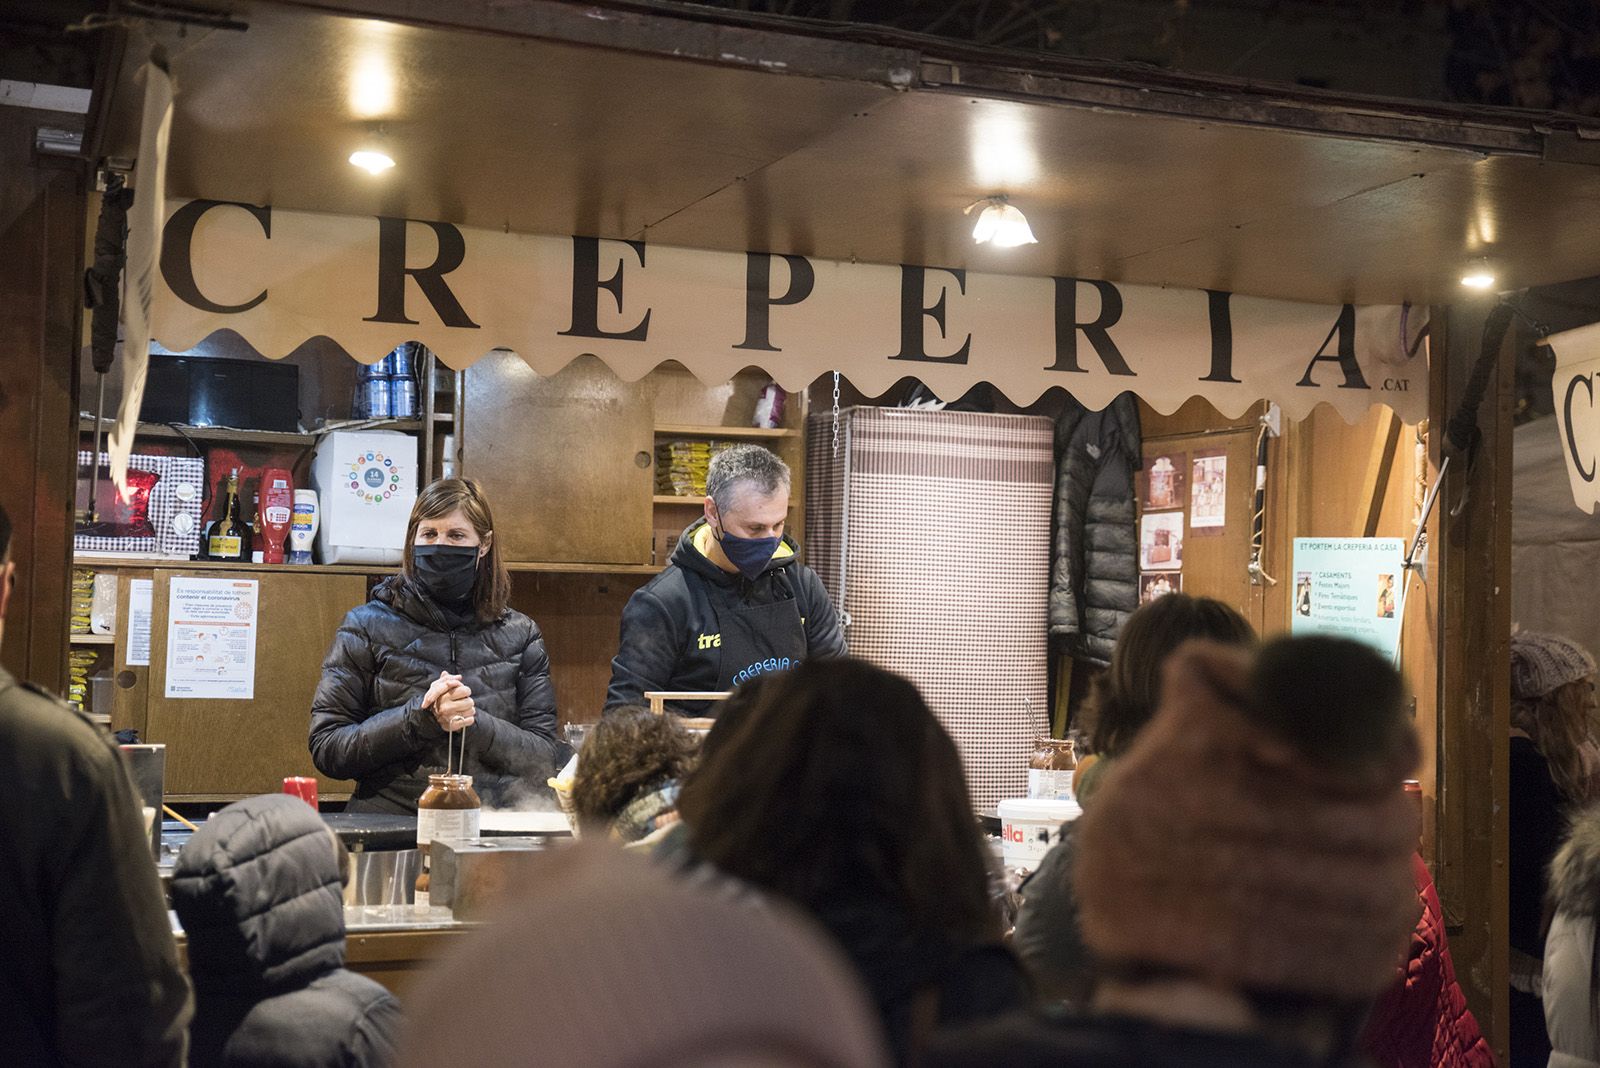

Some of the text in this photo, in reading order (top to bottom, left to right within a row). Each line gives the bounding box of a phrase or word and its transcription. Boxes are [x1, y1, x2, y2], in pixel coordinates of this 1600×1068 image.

[159, 199, 1410, 391] CREPERIA .CAT
[1563, 370, 1600, 482] C
[1343, 543, 1372, 551] CREPERIA
[732, 656, 790, 687] CREPERIA
